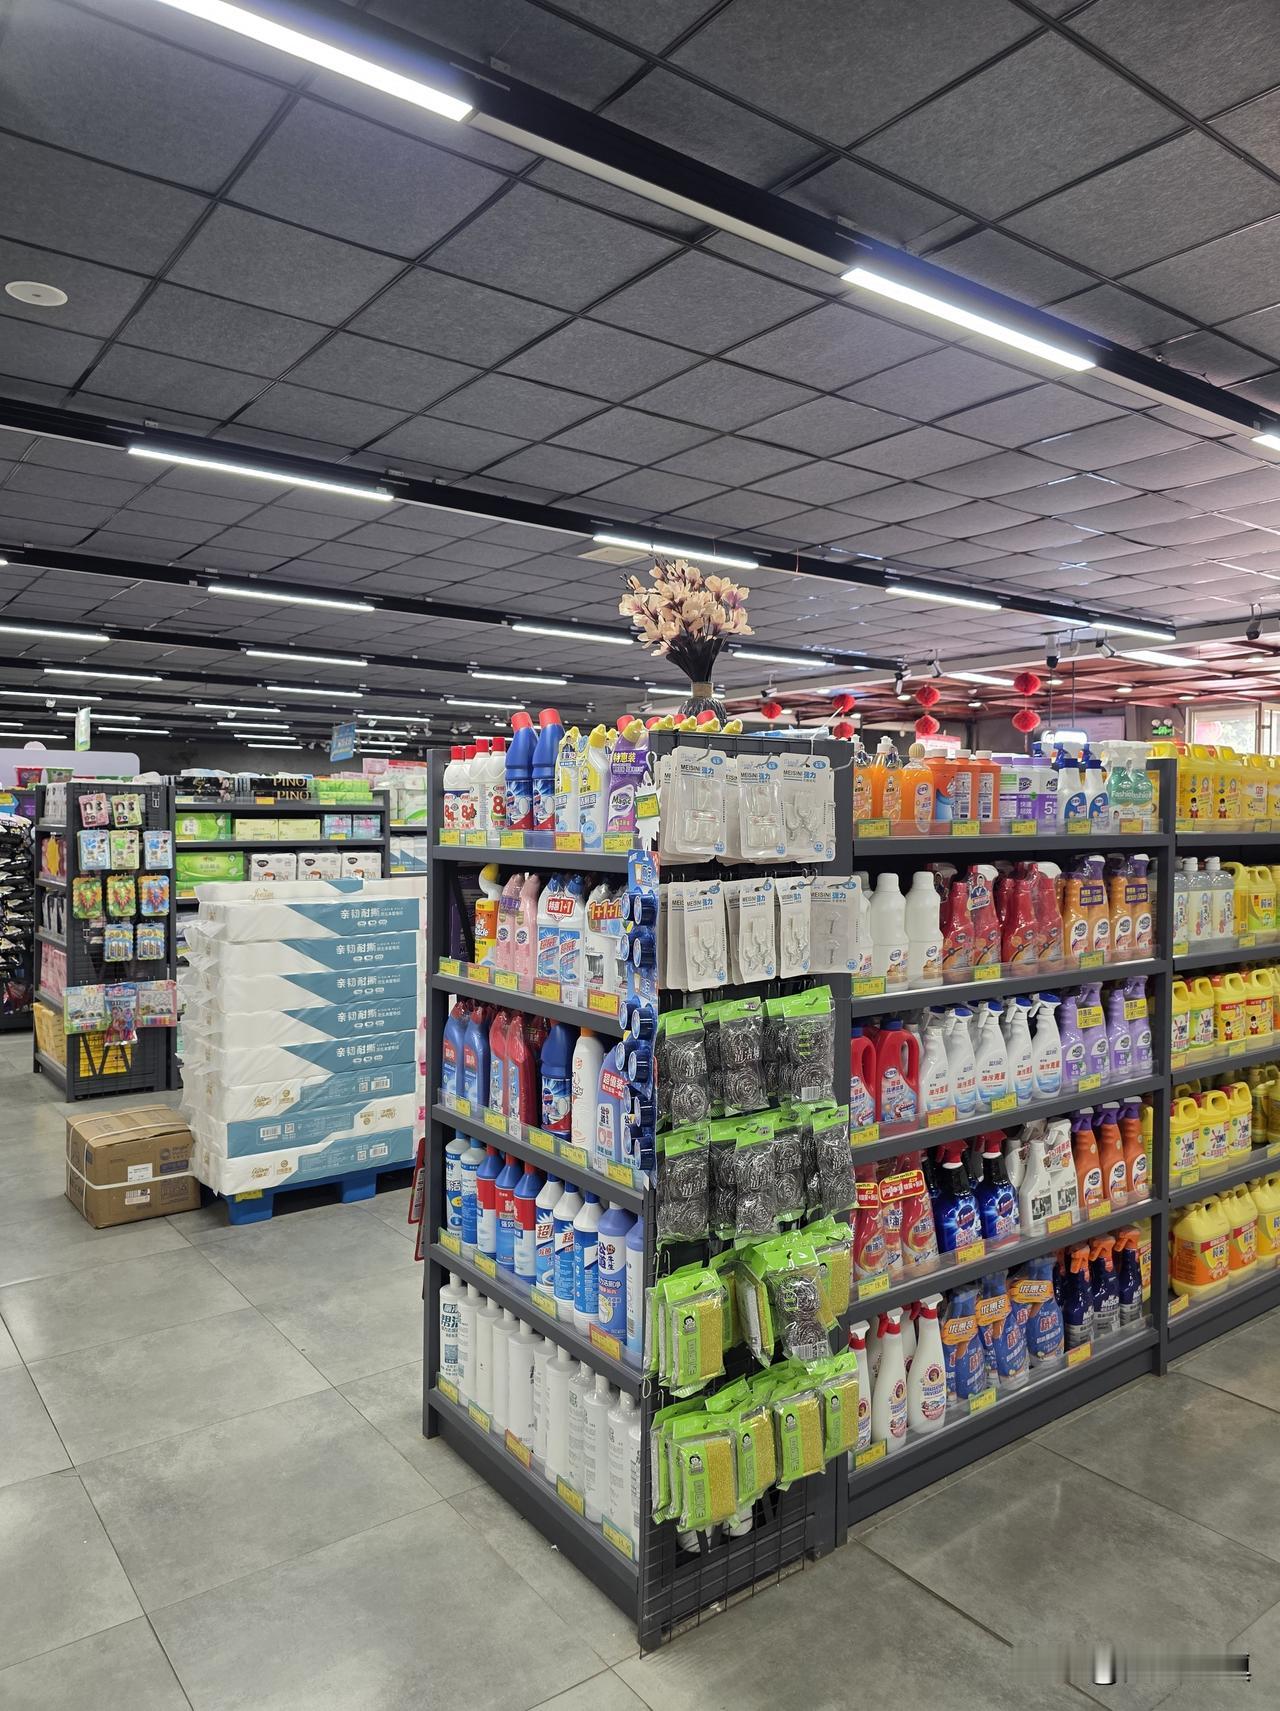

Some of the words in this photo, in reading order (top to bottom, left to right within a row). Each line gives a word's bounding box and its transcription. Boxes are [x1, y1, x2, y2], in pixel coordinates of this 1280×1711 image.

[613, 752, 636, 763] 特惠装
[680, 763, 701, 772] MEISINI
[273, 778, 306, 787] PINO
[277, 790, 309, 800] PINO
[611, 794, 632, 806] Magic
[340, 907, 380, 919] 亲韧耐撕
[336, 943, 376, 954] 亲韧耐撕
[337, 976, 377, 988] 亲韧耐撕
[337, 1008, 377, 1022] 亲韧耐撕
[336, 1044, 376, 1057] 亲韧耐撕
